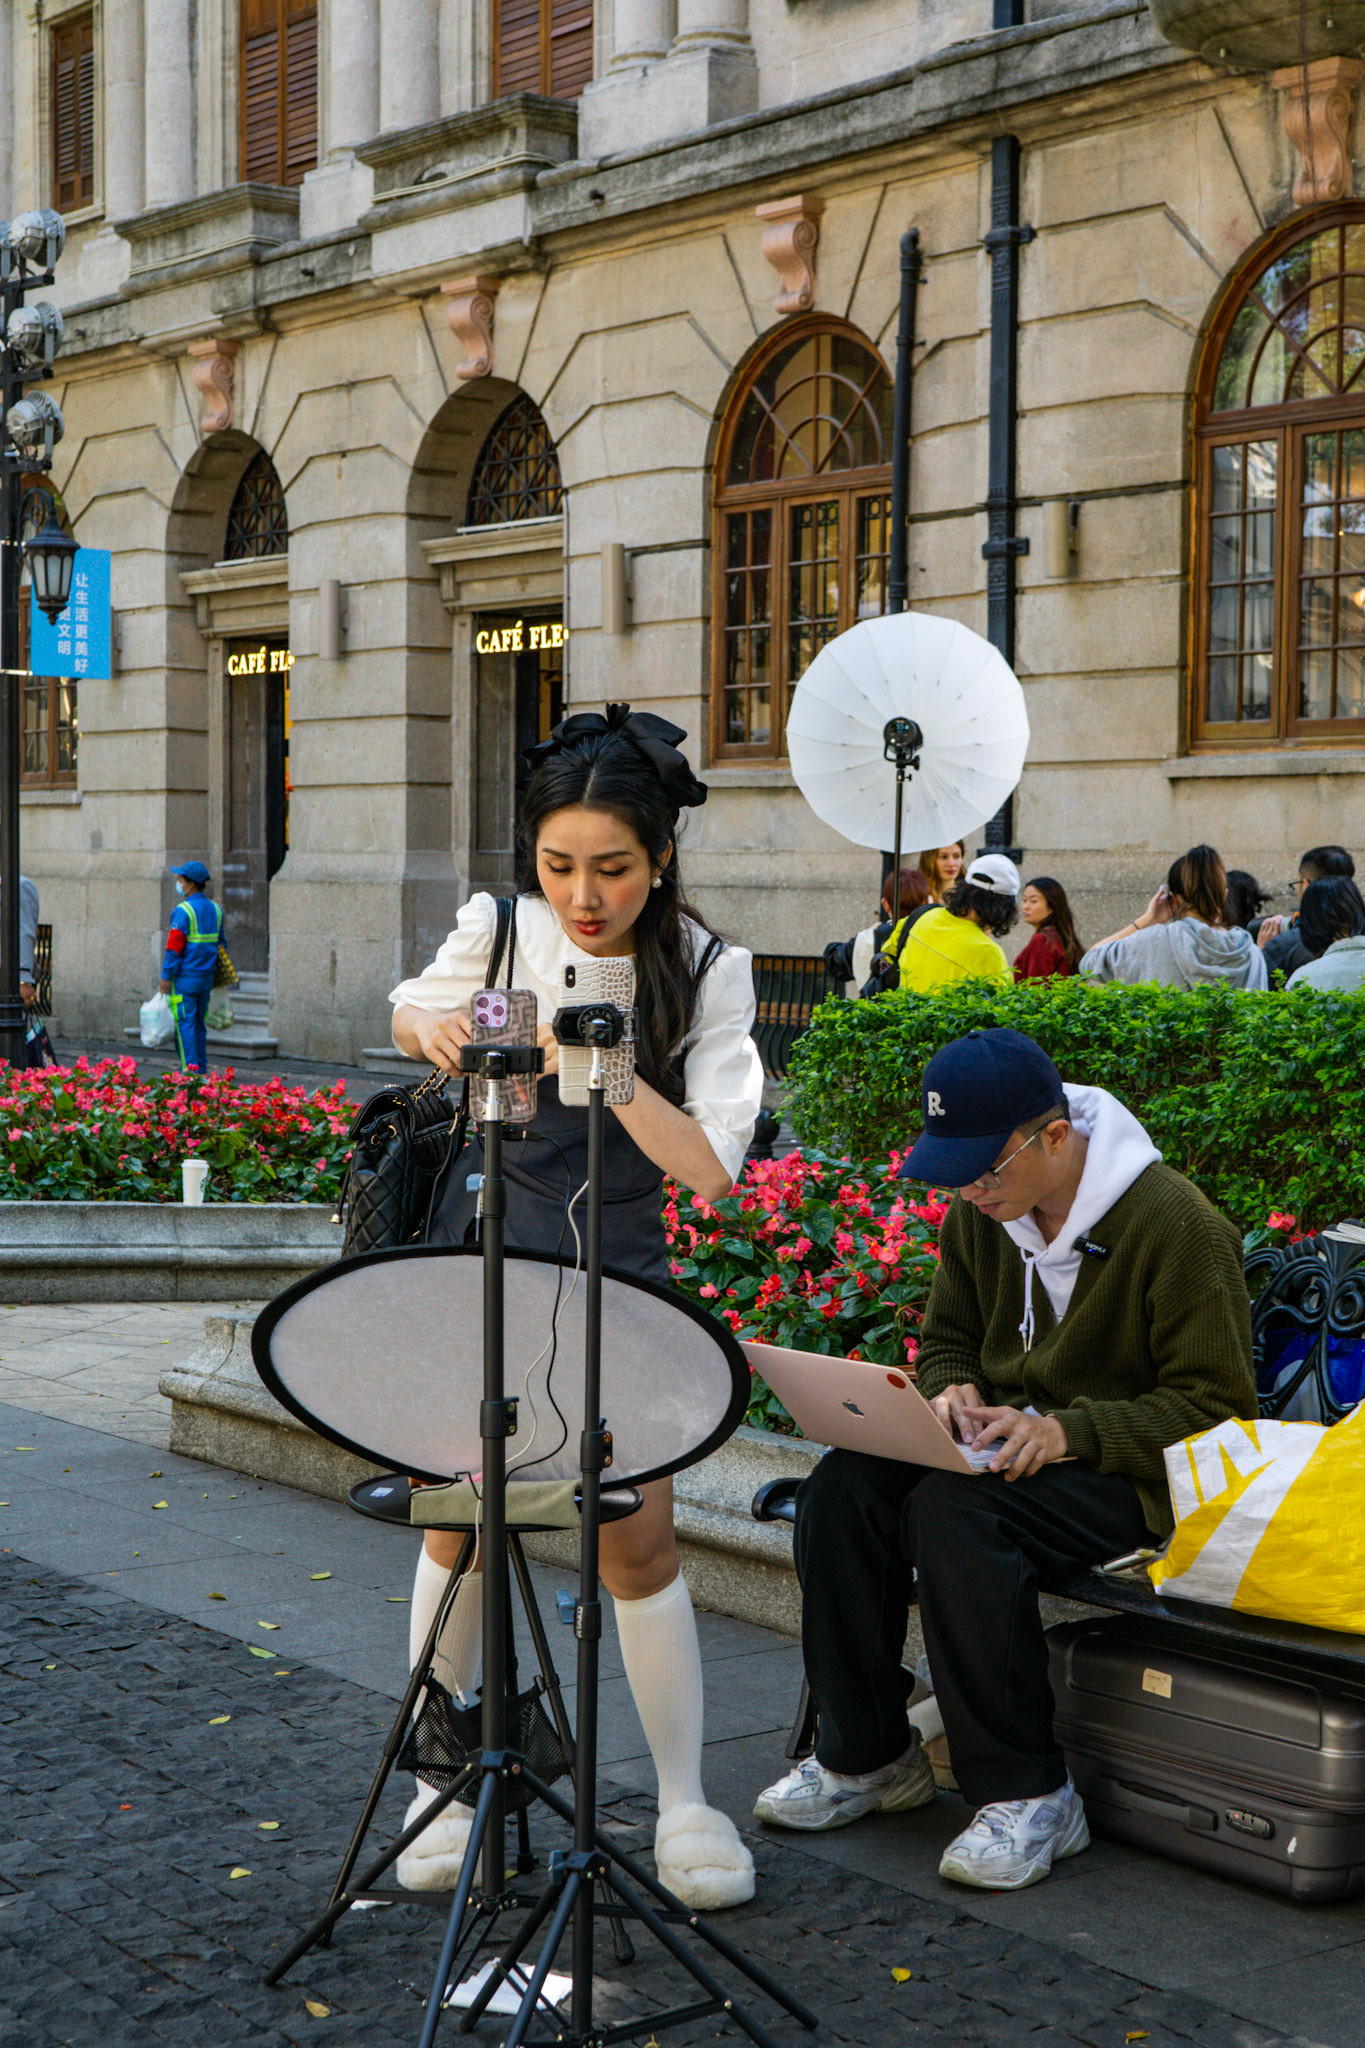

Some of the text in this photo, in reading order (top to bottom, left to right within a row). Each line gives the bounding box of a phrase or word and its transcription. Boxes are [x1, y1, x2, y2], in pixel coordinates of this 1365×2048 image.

[57, 592, 72, 655] 更文明
[74, 573, 89, 673] 让生活更美好
[476, 620, 523, 654] CAFÉ
[228, 646, 266, 676] CAFÉ
[927, 1091, 946, 1116] R
